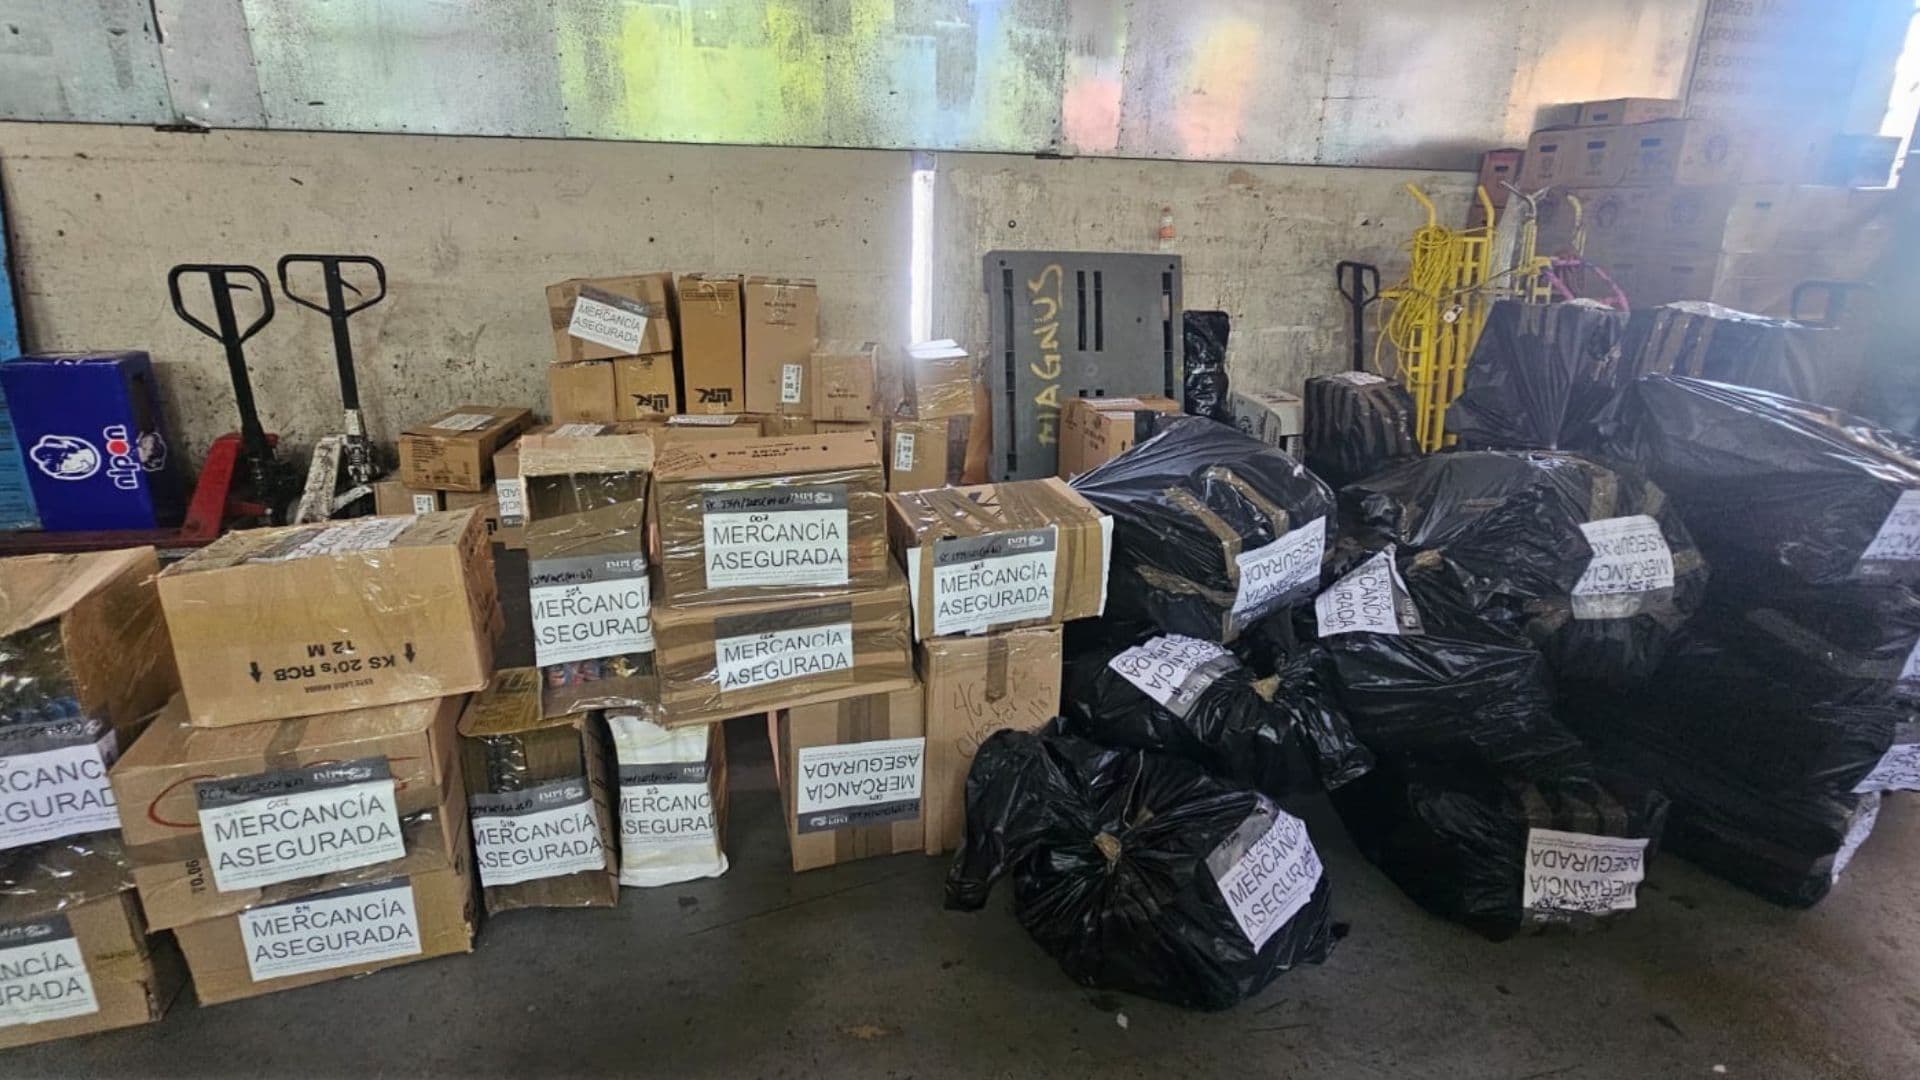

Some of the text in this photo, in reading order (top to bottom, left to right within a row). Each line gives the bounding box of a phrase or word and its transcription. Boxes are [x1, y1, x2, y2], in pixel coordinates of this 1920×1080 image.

[713, 519, 839, 545] MERCANCÍA
[711, 548, 842, 570] ASEGURADA
[941, 561, 1048, 594] MERCANCÍA
[534, 585, 651, 620] MERCANCÍ
[938, 586, 1049, 618] ASEGURADA
[307, 640, 356, 658] 12 M
[724, 629, 844, 663] MERCANCÍA
[273, 655, 395, 681] KS 20's RCB
[723, 652, 848, 687] ASEGURADA
[804, 753, 920, 779] ASEGURADA
[805, 774, 915, 803] MERCANCÍA
[0, 787, 118, 825] GURAD
[214, 792, 386, 842] MERCANCÍA
[218, 821, 395, 870] ASEGURADA
[1531, 848, 1641, 874] ASEGURADA
[252, 898, 406, 938] MERCANCÍA
[255, 923, 413, 962] ASEGURADA
[0, 952, 75, 982] NCÍA
[0, 976, 85, 1007] RADA
